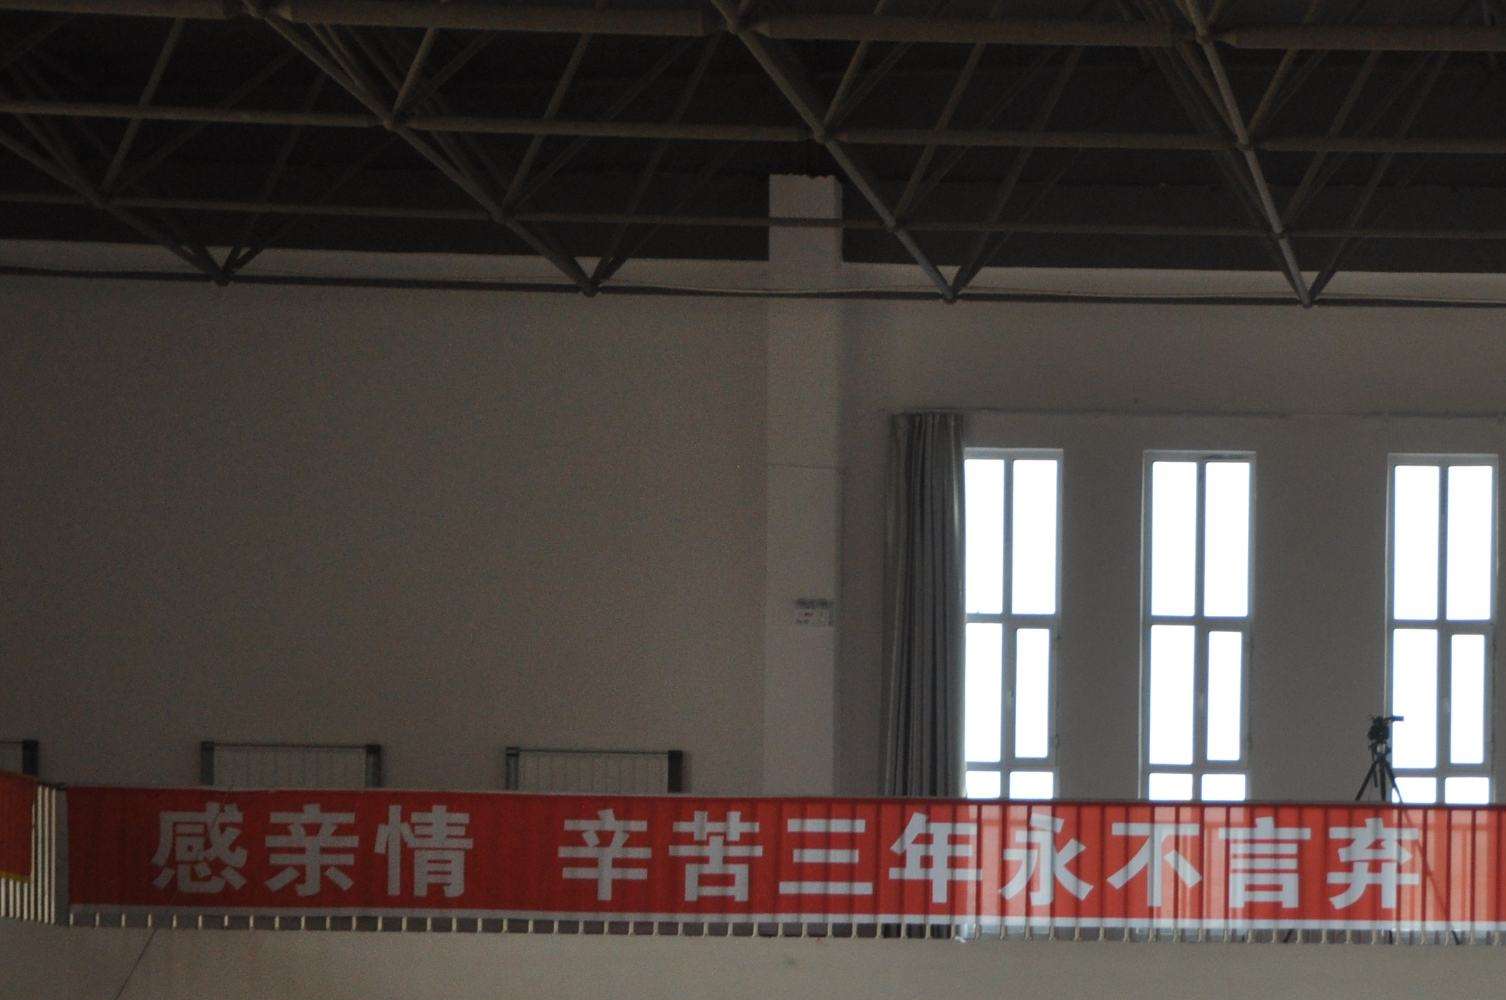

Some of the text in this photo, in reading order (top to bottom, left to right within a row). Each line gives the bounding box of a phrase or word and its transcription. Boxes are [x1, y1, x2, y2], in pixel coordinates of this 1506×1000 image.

[152, 801, 473, 898] 感亲情
[557, 808, 1420, 910] 辛苦三年永不言弃
